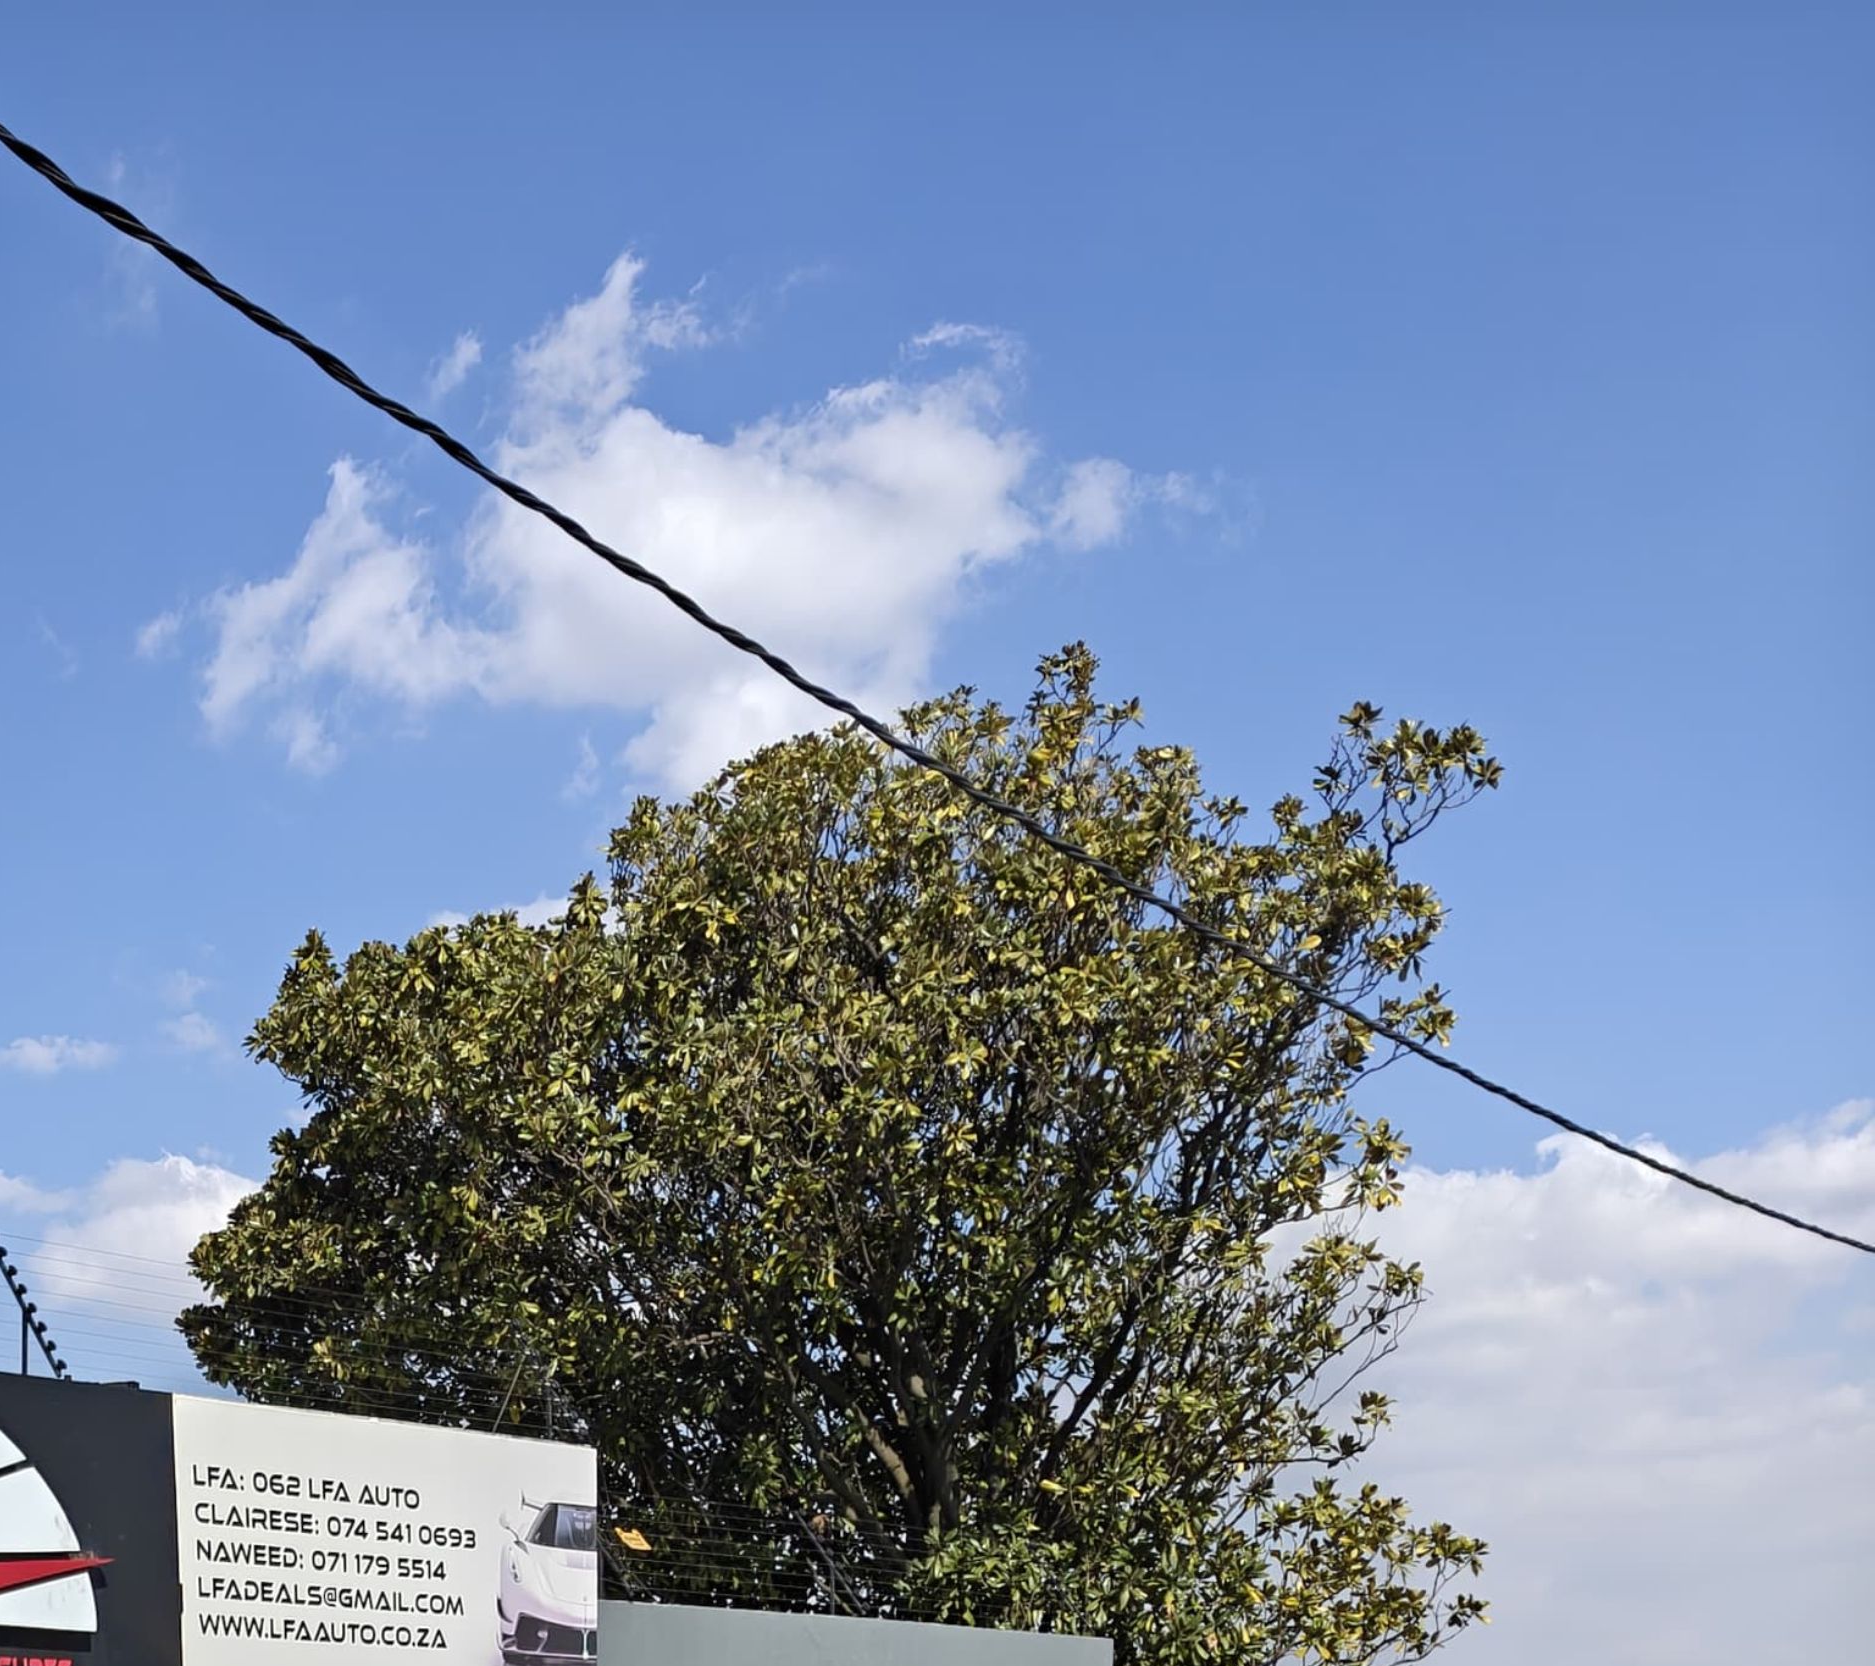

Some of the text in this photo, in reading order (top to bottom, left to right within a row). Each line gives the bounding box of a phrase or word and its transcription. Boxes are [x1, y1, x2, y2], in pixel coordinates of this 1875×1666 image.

[192, 1464, 420, 1510] LFA: 062 LFA AUTO
[194, 1503, 476, 1549] CLAIRESE: 074 541 0693
[196, 1540, 447, 1581] NAWEED: 071 179 5514
[197, 1577, 464, 1616] LFADEALS@GMAIL.COM
[199, 1614, 447, 1649] WWW.LFAAUTO.CO.ZA
